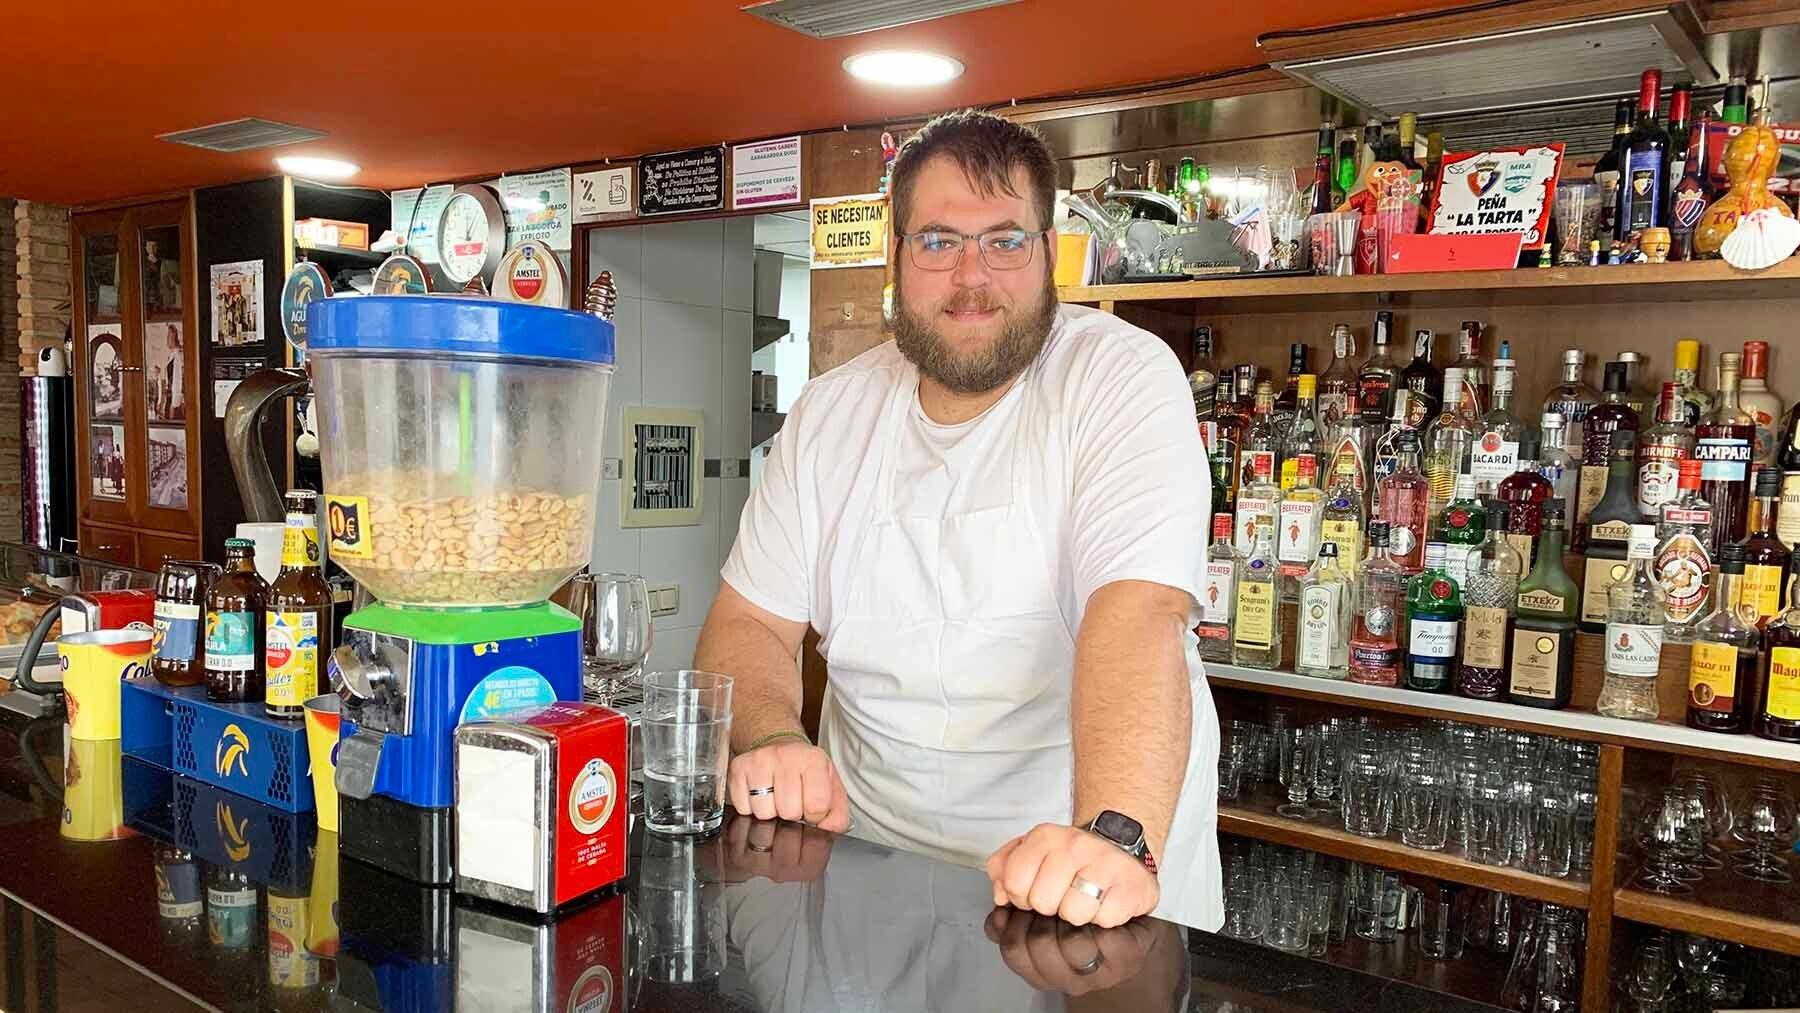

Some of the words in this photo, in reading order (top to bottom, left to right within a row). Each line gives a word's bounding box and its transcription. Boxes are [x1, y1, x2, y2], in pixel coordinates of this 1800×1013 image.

[1477, 194, 1507, 210] PEÑA
[816, 209, 828, 225] SE
[830, 205, 883, 225] NECESITAN
[826, 230, 871, 248] CLIENTES
[516, 269, 539, 277] AMSTEL
[1695, 446, 1751, 460] CAMPARI
[1239, 502, 1266, 511] BEEFEATER
[1282, 504, 1312, 514] BEEFEATER
[1521, 594, 1560, 606] ETXEKO
[582, 785, 606, 801] AMSTEL
